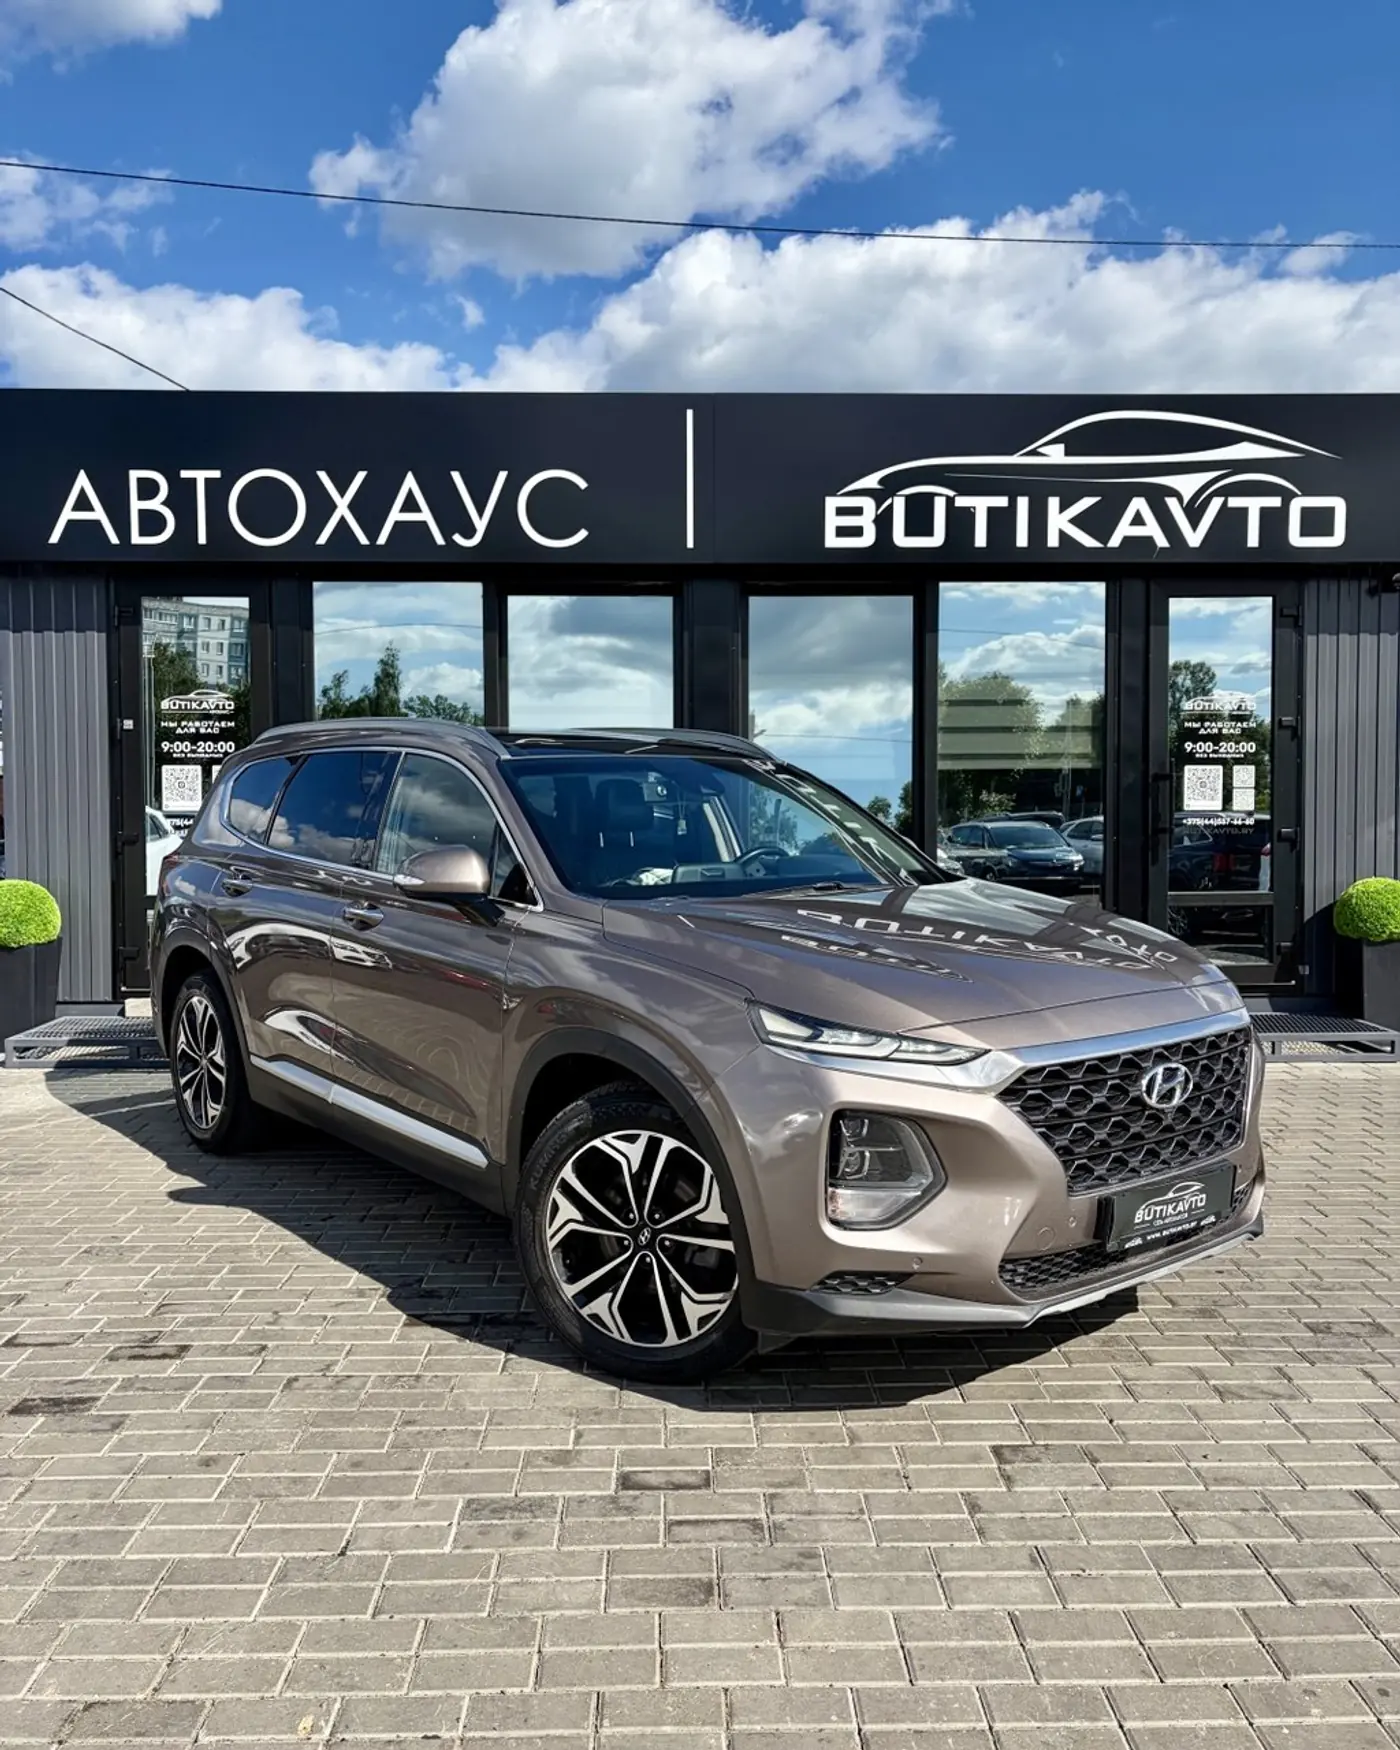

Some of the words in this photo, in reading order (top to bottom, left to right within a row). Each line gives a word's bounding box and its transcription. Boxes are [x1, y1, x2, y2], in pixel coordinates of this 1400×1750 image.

[48, 467, 590, 548] АВТОХАУС
[823, 495, 1348, 549] BUTIKAVTO
[160, 700, 235, 710] BUTIKAVTO
[1184, 701, 1257, 711] BUTIKAVTO
[181, 720, 235, 728] РАБОТАЕМ
[1184, 721, 1202, 729] МЫ
[1204, 721, 1257, 729] РАБОТАЕМ
[160, 741, 235, 753] 9:00-20:00
[1184, 741, 1257, 754] 9:00-20:00
[1134, 1193, 1207, 1224] BUTIKAVTO
